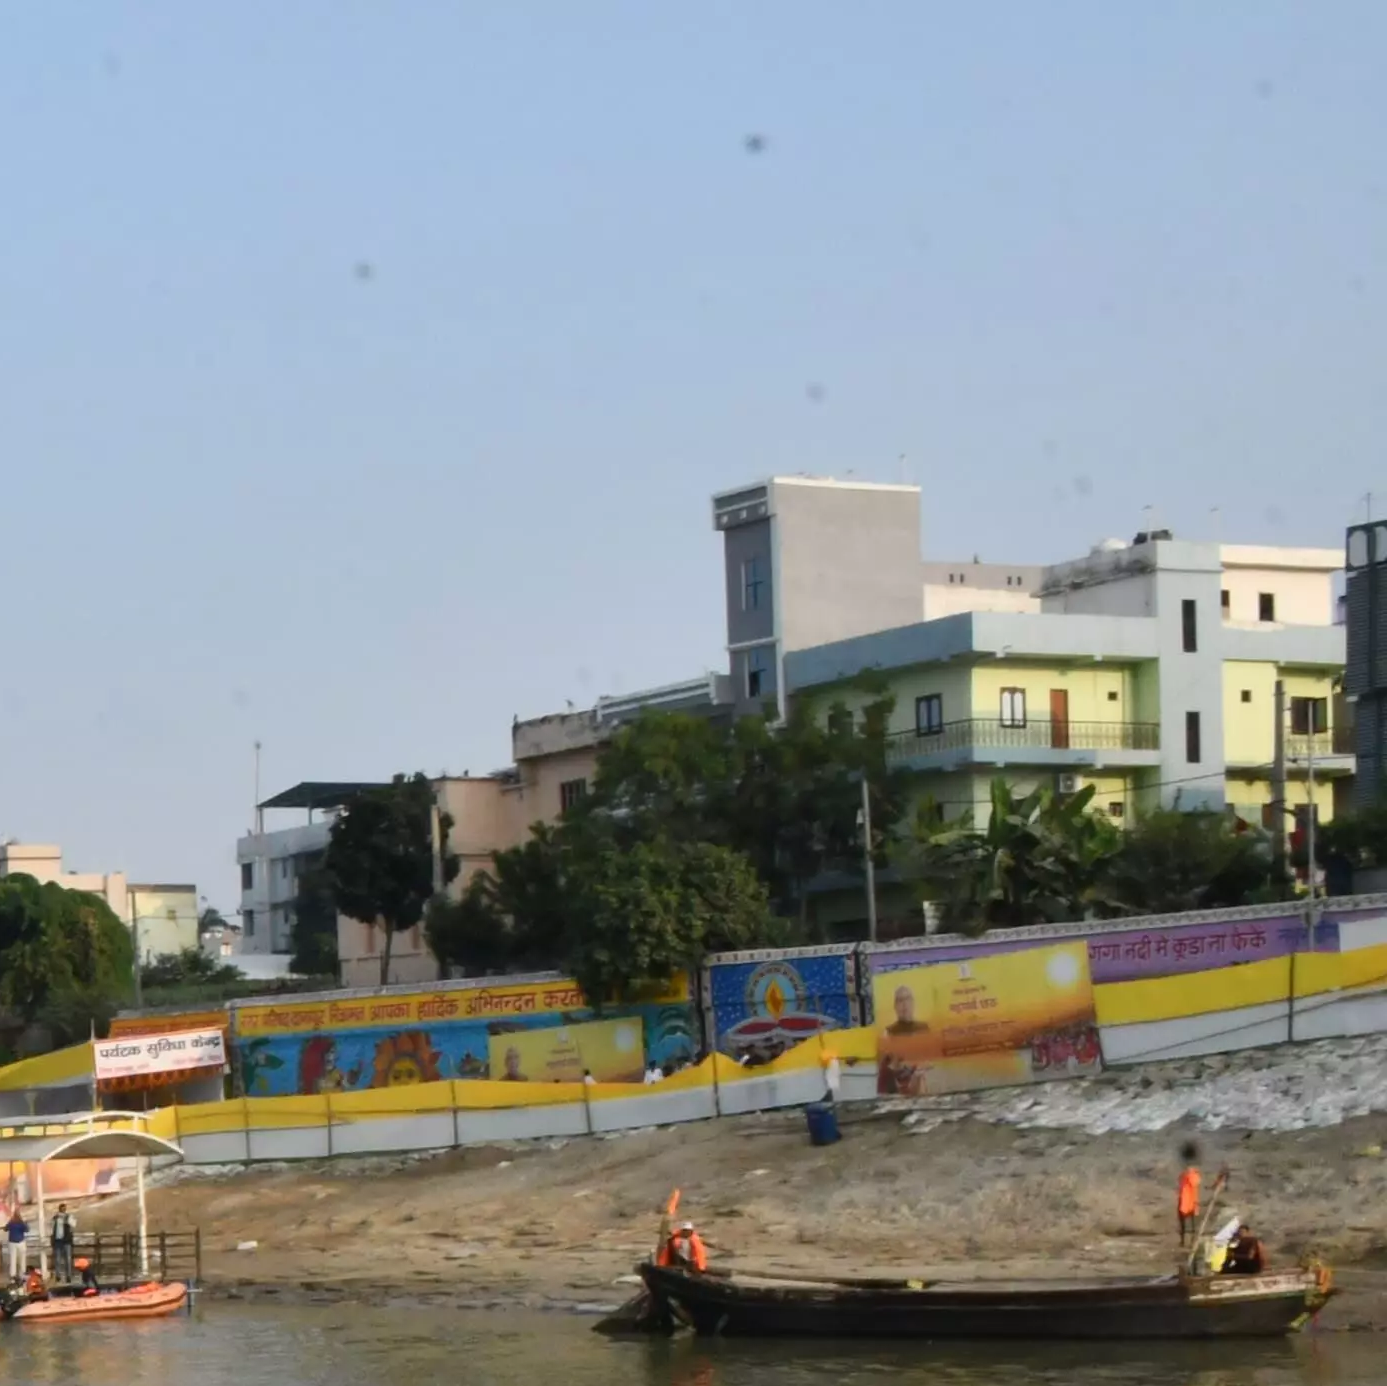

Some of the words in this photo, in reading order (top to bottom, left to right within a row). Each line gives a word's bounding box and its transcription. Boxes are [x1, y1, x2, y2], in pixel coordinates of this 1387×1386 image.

[370, 1002, 411, 1021] आपका
[417, 994, 459, 1020] हार्दिक
[100, 1043, 141, 1058] पर्यटक
[147, 1037, 186, 1059] सुविधा
